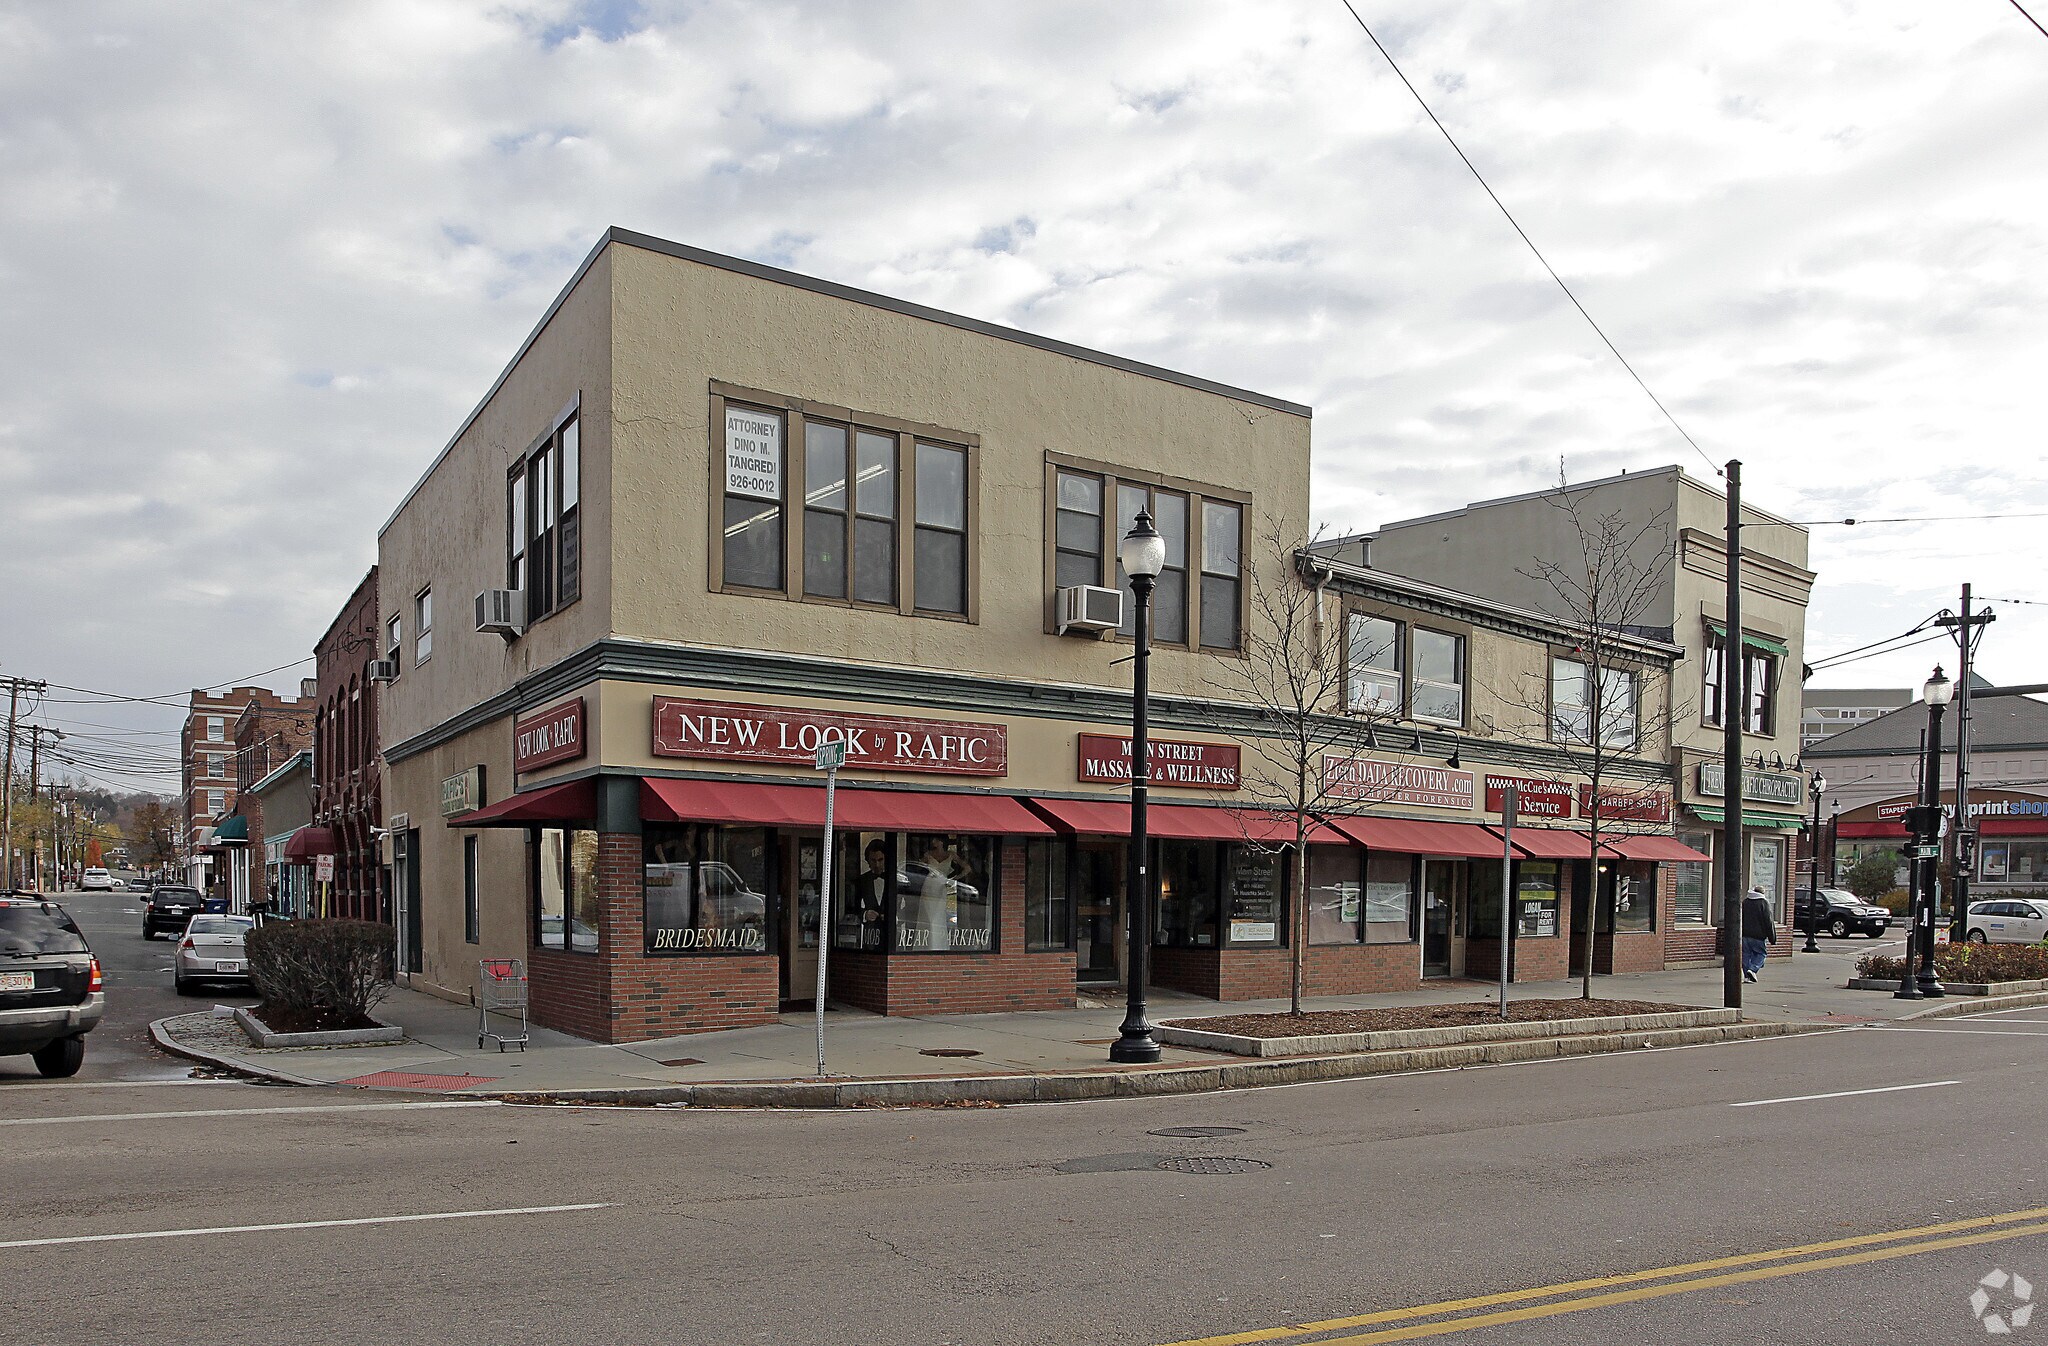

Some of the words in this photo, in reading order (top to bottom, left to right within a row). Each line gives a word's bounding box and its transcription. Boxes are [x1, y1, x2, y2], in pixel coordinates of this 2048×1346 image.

[728, 417, 775, 437] ATTORNEY
[734, 437, 756, 453] DINO
[760, 442, 770, 455] M.
[728, 455, 776, 474] TANGREDI
[730, 474, 774, 492] 926-0012
[518, 731, 531, 760] NEW
[533, 725, 550, 755] LOOK
[554, 715, 576, 748] RAFIC
[679, 714, 765, 746] NEW
[874, 733, 887, 751] by
[894, 731, 988, 763] RAFIC
[817, 744, 839, 766] SPRING
[1121, 740, 1155, 758] MN
[1158, 743, 1203, 760] STREET
[1086, 758, 1152, 780] MASSAE
[1155, 767, 1163, 780] &
[1166, 763, 1235, 785] WELLNESS
[1358, 762, 1389, 786] DATA
[1390, 767, 1449, 790] RECOVERY
[1451, 778, 1472, 793] .com
[1516, 779, 1548, 794] McCue's
[1416, 795, 1472, 807] FORENSICS
[1524, 796, 1560, 814] Service
[1253, 866, 1273, 876] Street
[1525, 901, 1541, 914] LOGAN
[1540, 911, 1552, 919] FOR
[1539, 918, 1553, 926] RENT
[898, 928, 930, 947] REAR
